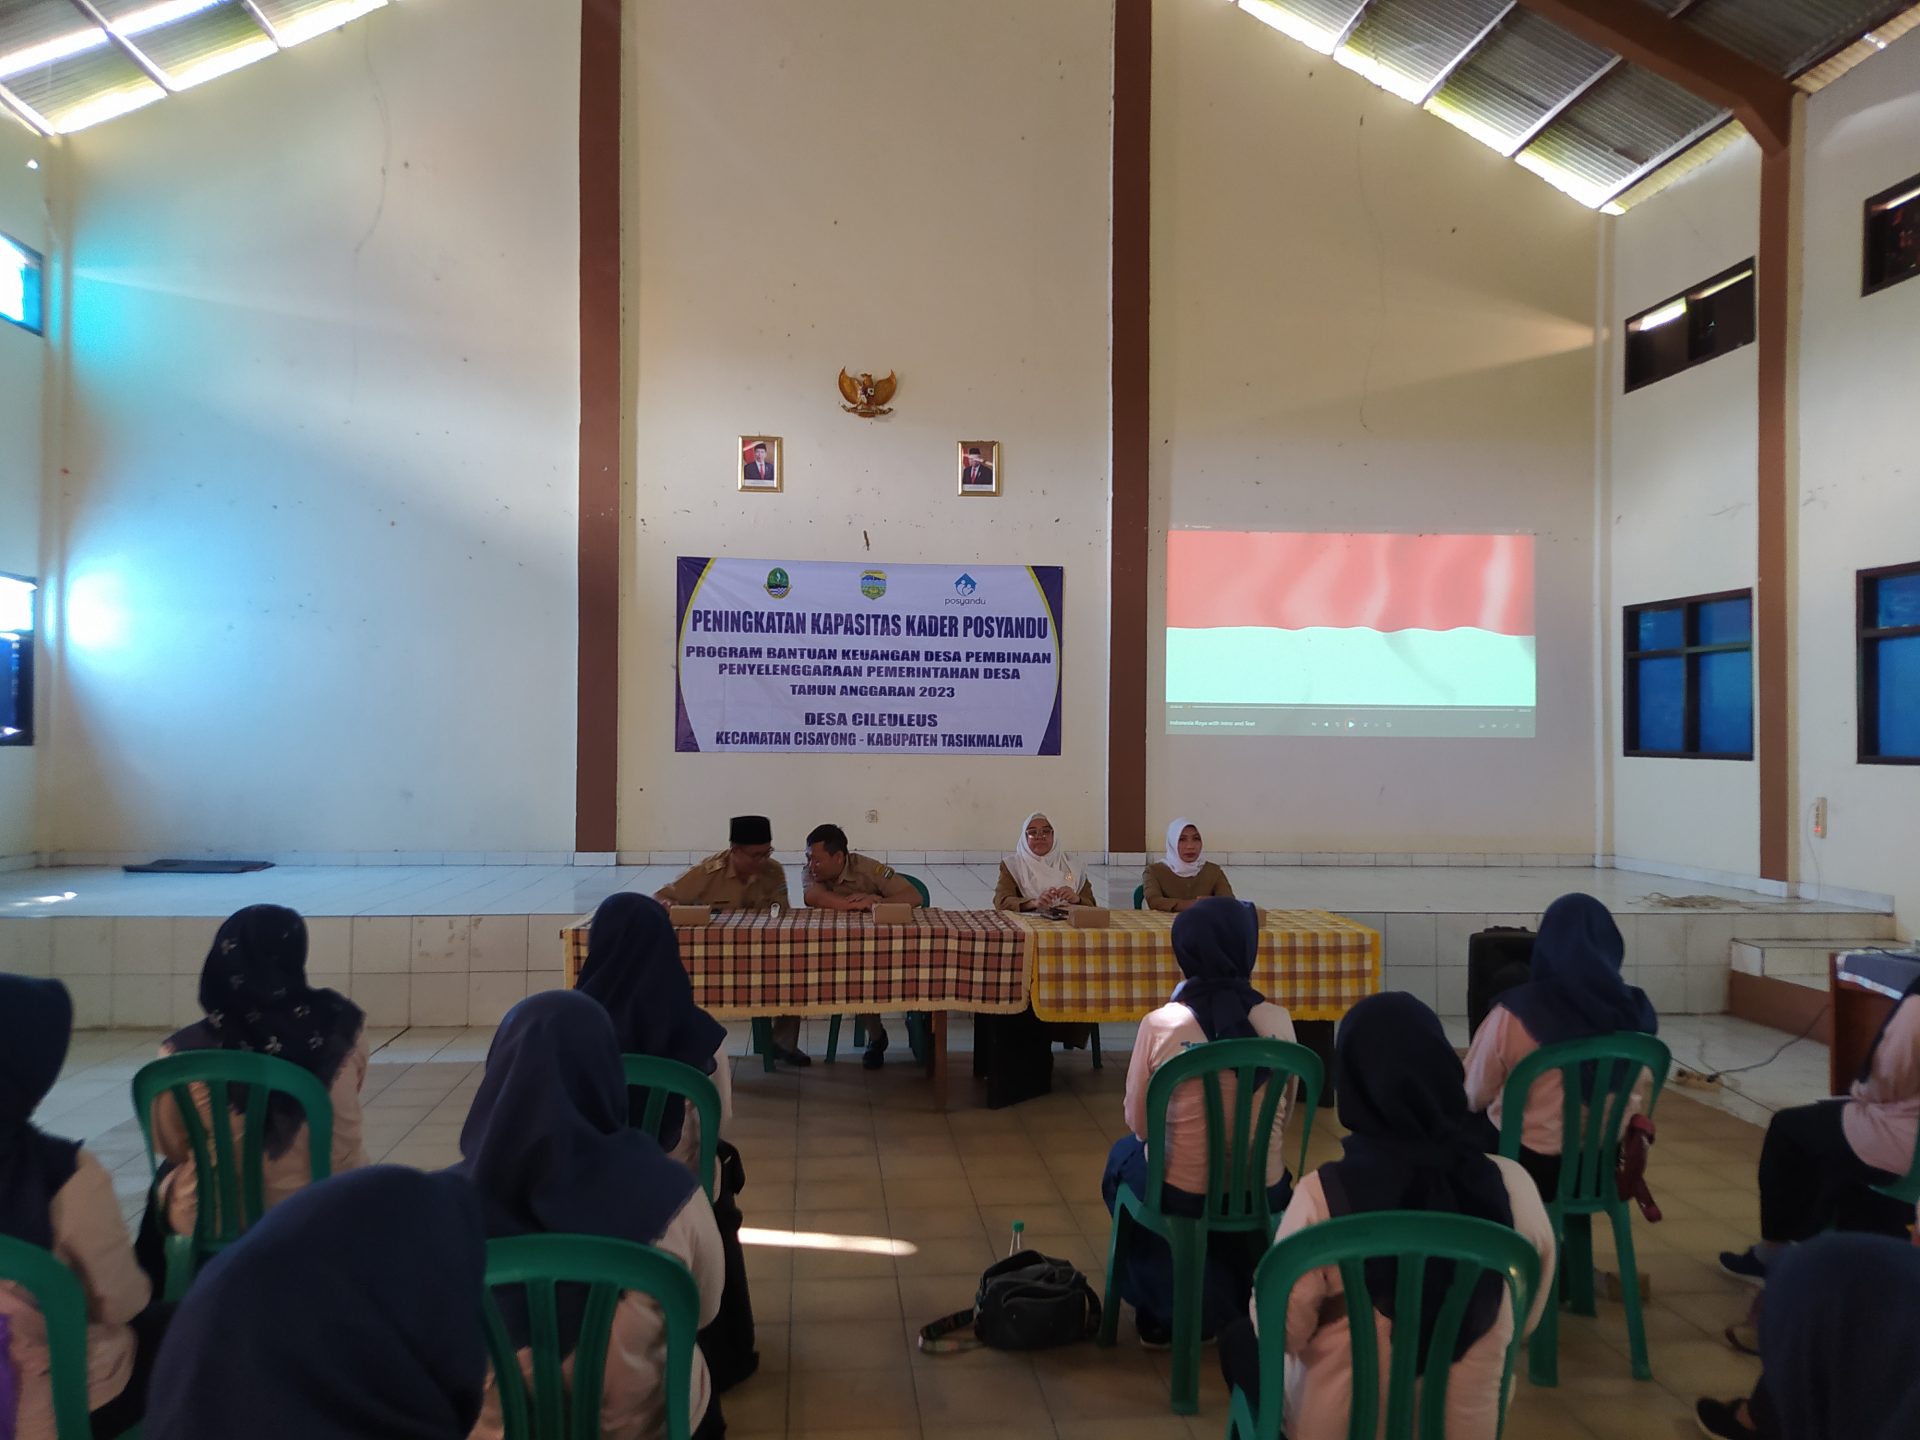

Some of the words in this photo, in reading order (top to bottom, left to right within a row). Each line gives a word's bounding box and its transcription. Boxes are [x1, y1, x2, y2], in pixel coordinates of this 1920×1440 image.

[943, 597, 987, 607] posyandu
[692, 609, 806, 635] PENINGKATAN
[810, 612, 901, 637] KAPASITAS
[905, 615, 959, 638] KADER
[962, 616, 1048, 640] POSYANDU
[685, 645, 763, 659] PROGRAM
[766, 647, 838, 660] BANTUAN
[841, 648, 921, 662] KEUANGAN
[924, 650, 962, 662] DESA
[965, 651, 1052, 664] PEMBINAAN
[718, 663, 863, 677] PENYELENGGARAAN
[866, 665, 980, 679] PEMERINTAHAN
[983, 667, 1021, 680] DESA
[790, 684, 837, 696] TAHUN
[839, 685, 916, 697] ANGGARAN
[919, 686, 956, 698] 2023
[804, 712, 848, 726] DESA
[851, 712, 938, 728] CILEULEUS
[715, 731, 791, 745] KECAMATAN
[794, 732, 857, 746] CISAYONG
[866, 733, 938, 747] KABUPATEN
[941, 734, 1024, 748] TASIKMALAYA
